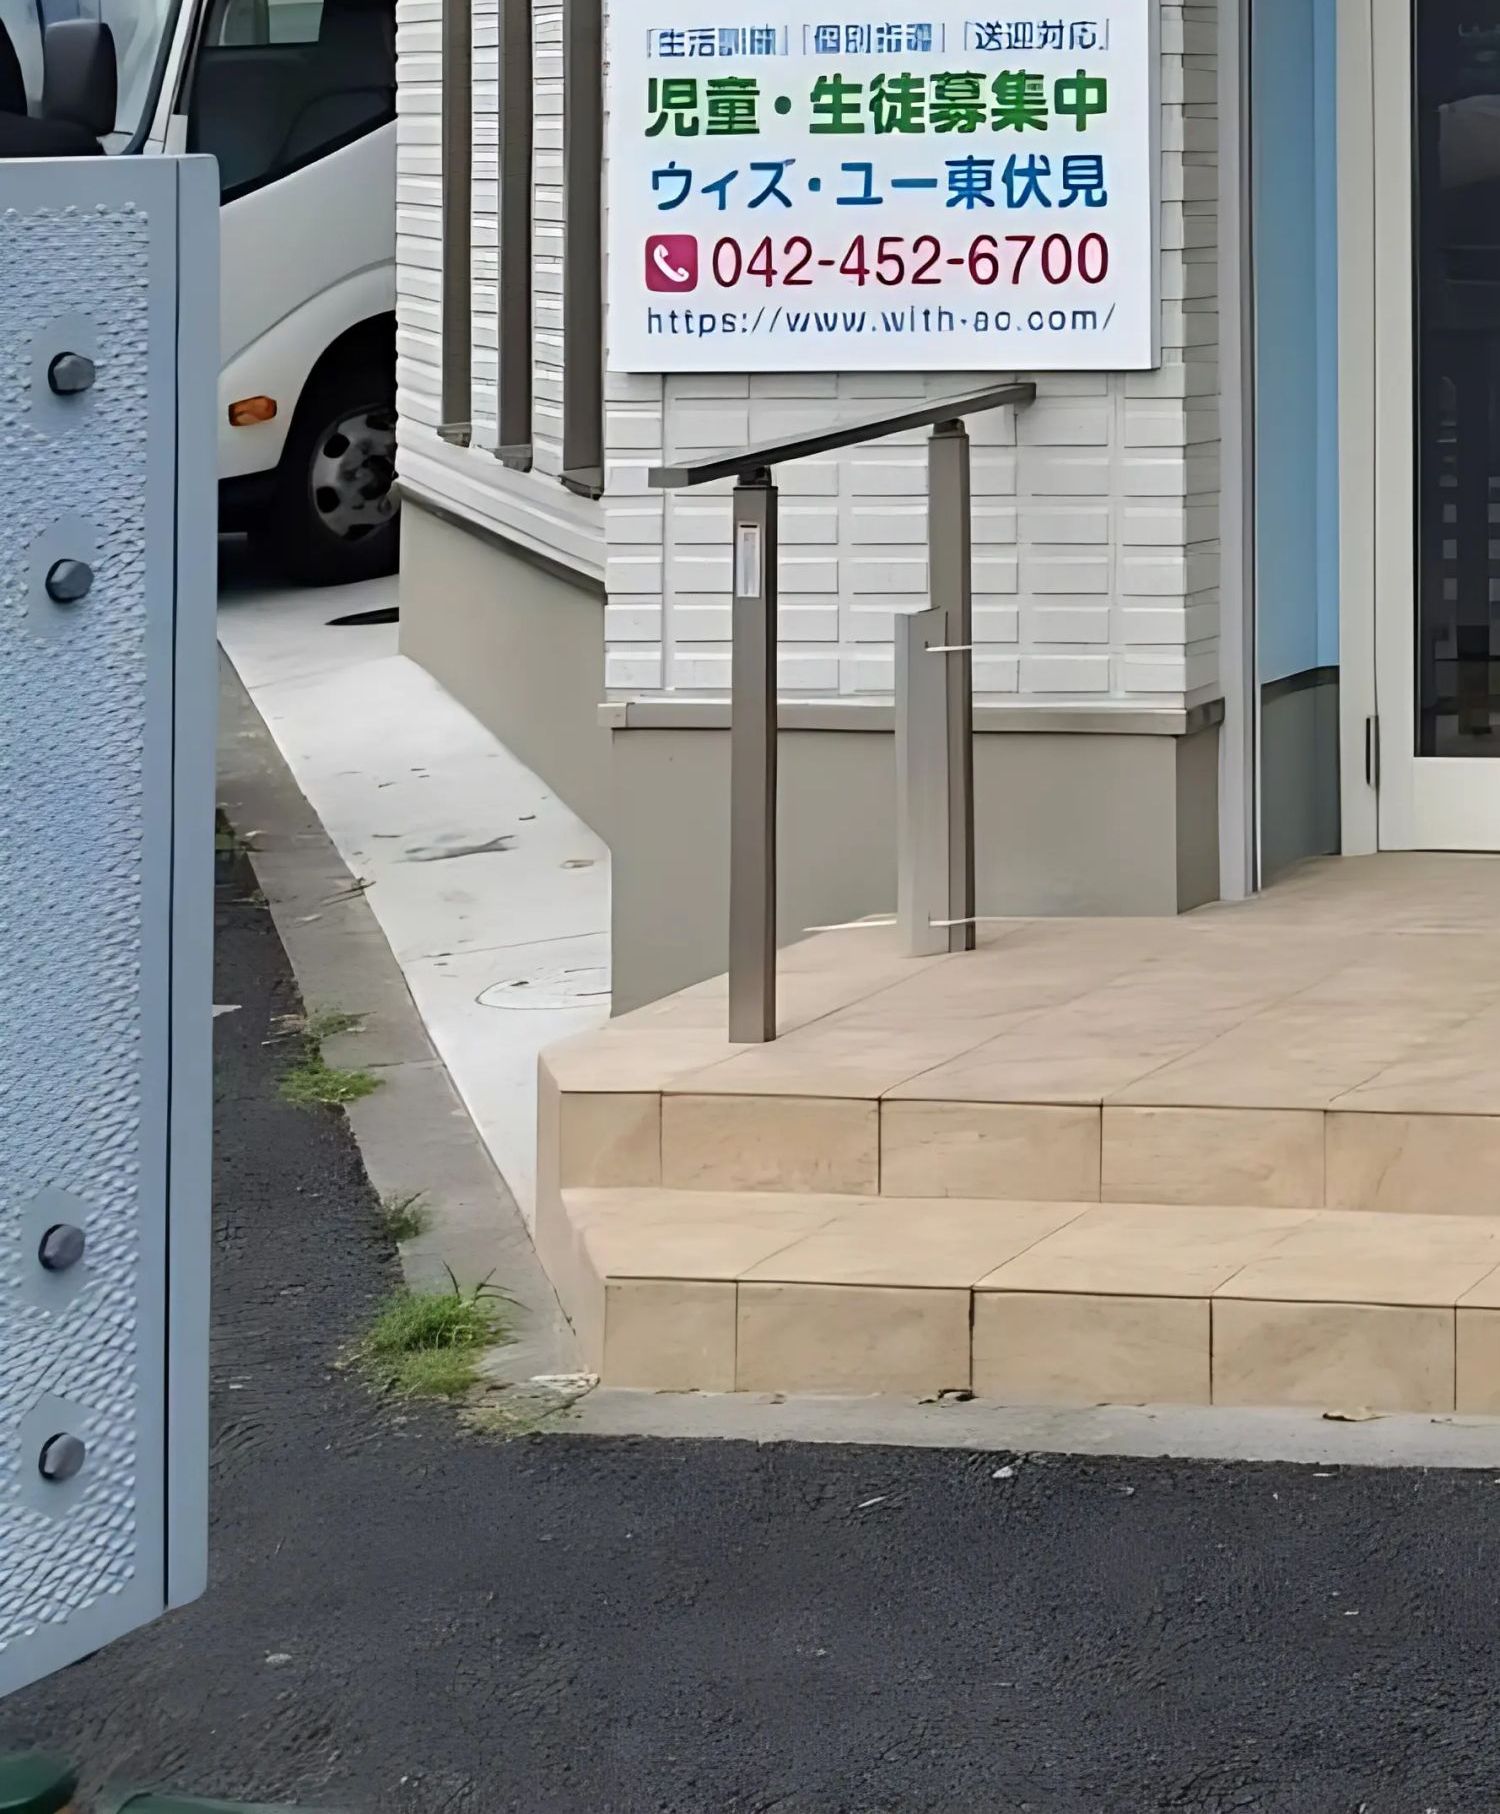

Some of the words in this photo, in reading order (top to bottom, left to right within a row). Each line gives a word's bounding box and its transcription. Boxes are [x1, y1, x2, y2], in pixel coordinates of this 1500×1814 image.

[646, 25, 789, 58] 「生活」
[802, 23, 946, 54] 「個別」
[644, 68, 1108, 137] 児童・生徒募集中
[651, 153, 1108, 211] ウィズ・ユー東伏見
[711, 231, 1109, 287] 042-452-6700
